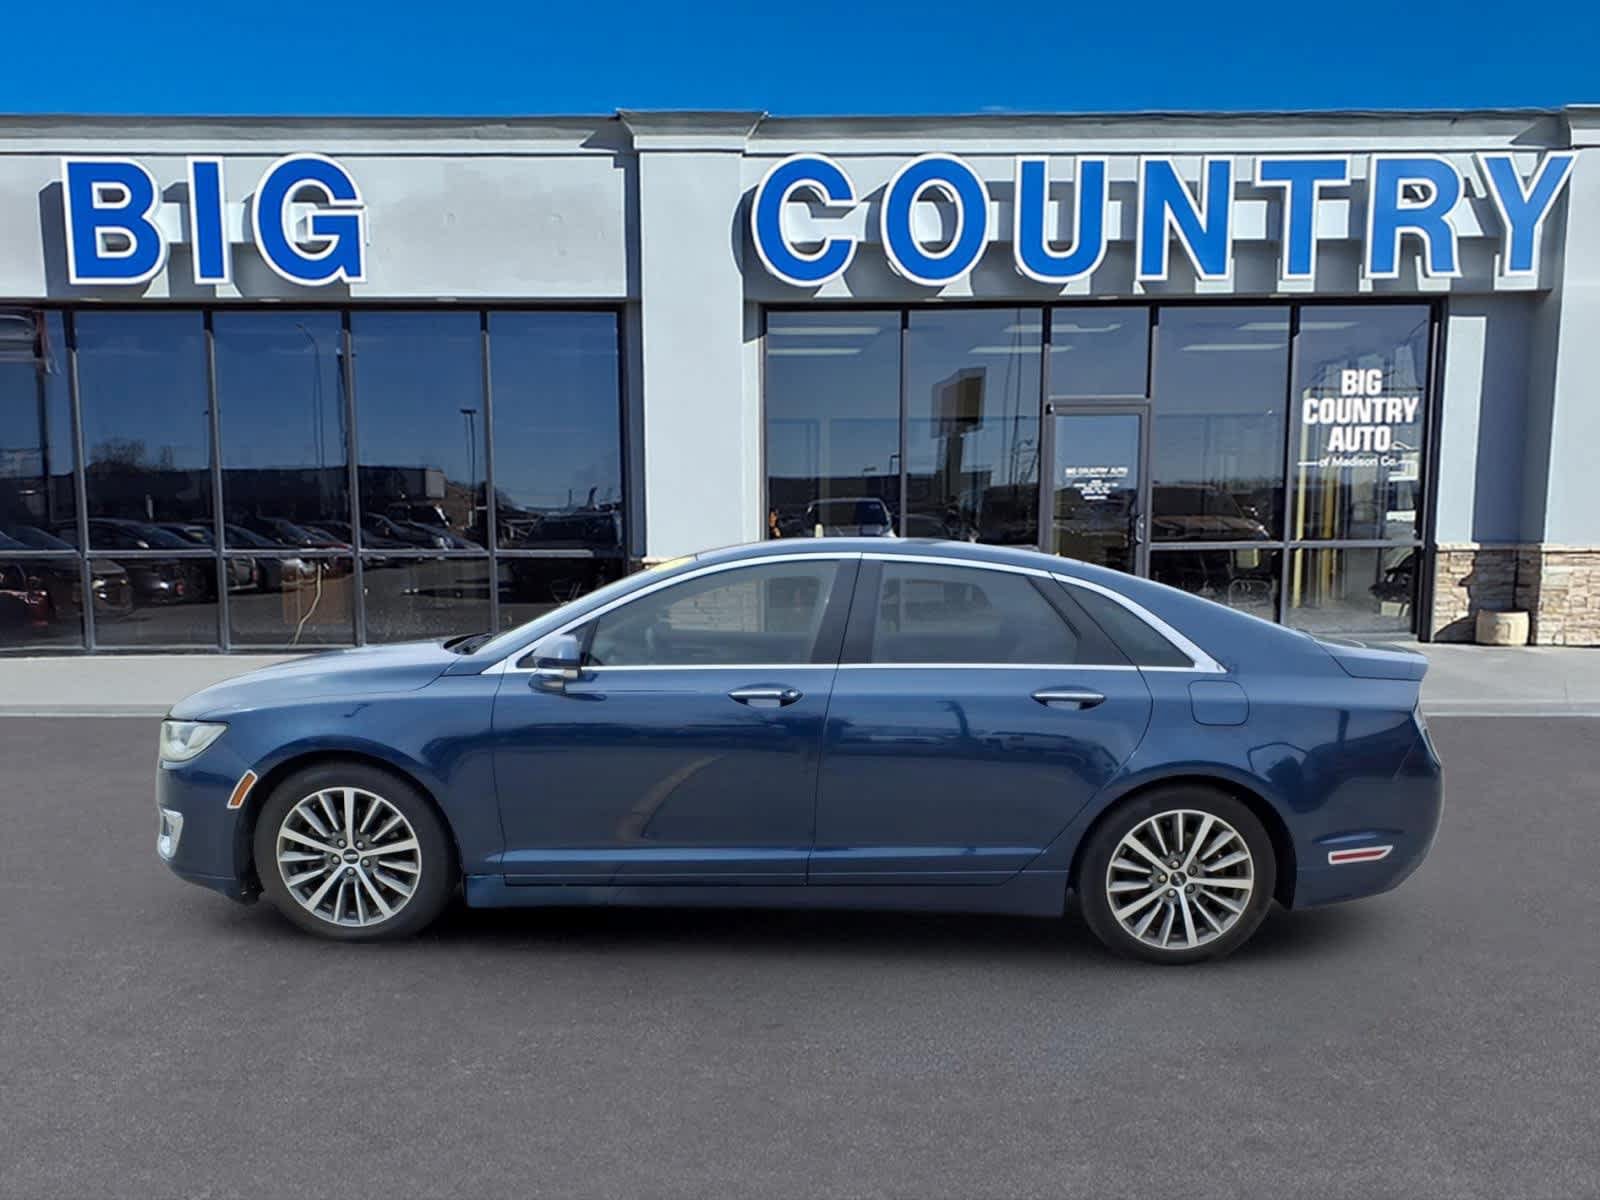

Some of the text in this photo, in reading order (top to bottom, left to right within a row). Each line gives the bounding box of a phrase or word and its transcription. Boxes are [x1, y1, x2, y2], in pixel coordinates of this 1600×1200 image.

[61, 152, 1576, 288] BIG COUNTRY
[1341, 369, 1382, 396] BIG
[1303, 397, 1419, 424] COUNTRY
[1328, 426, 1391, 452] AUTO
[1319, 455, 1330, 467] of
[1331, 455, 1378, 466] Madison
